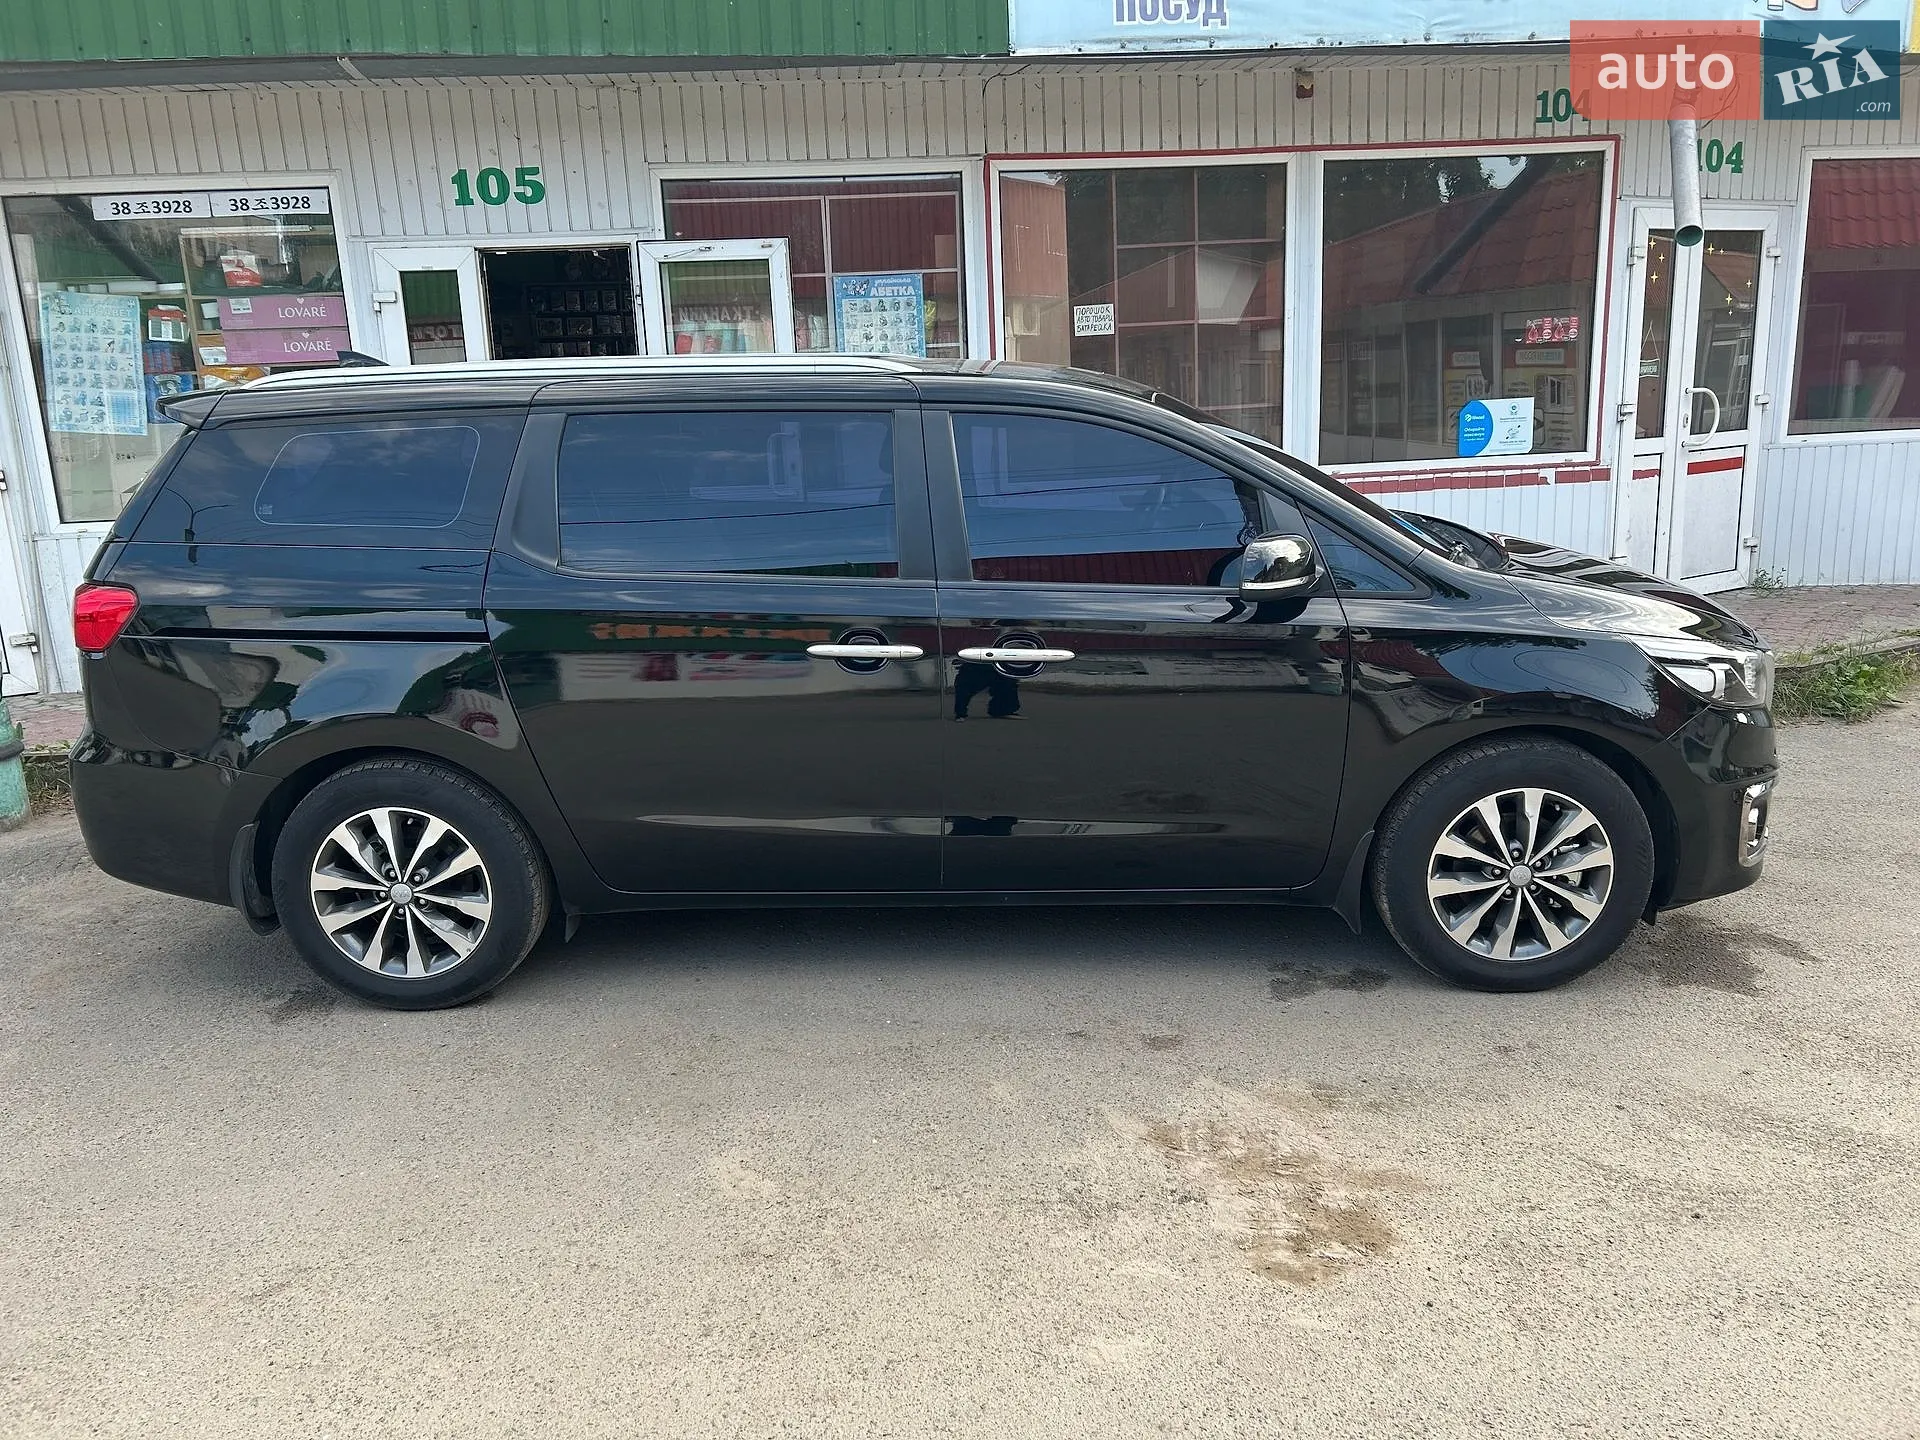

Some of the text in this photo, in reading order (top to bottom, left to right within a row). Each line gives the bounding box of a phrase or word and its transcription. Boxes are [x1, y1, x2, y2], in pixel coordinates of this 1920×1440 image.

[451, 166, 546, 207] 105
[110, 200, 193, 216] 38조3928
[228, 195, 312, 212] 38조3928
[869, 285, 916, 297] АБЕТКА
[278, 303, 327, 318] LOVARÉ
[283, 338, 333, 353] LOVARÉ
